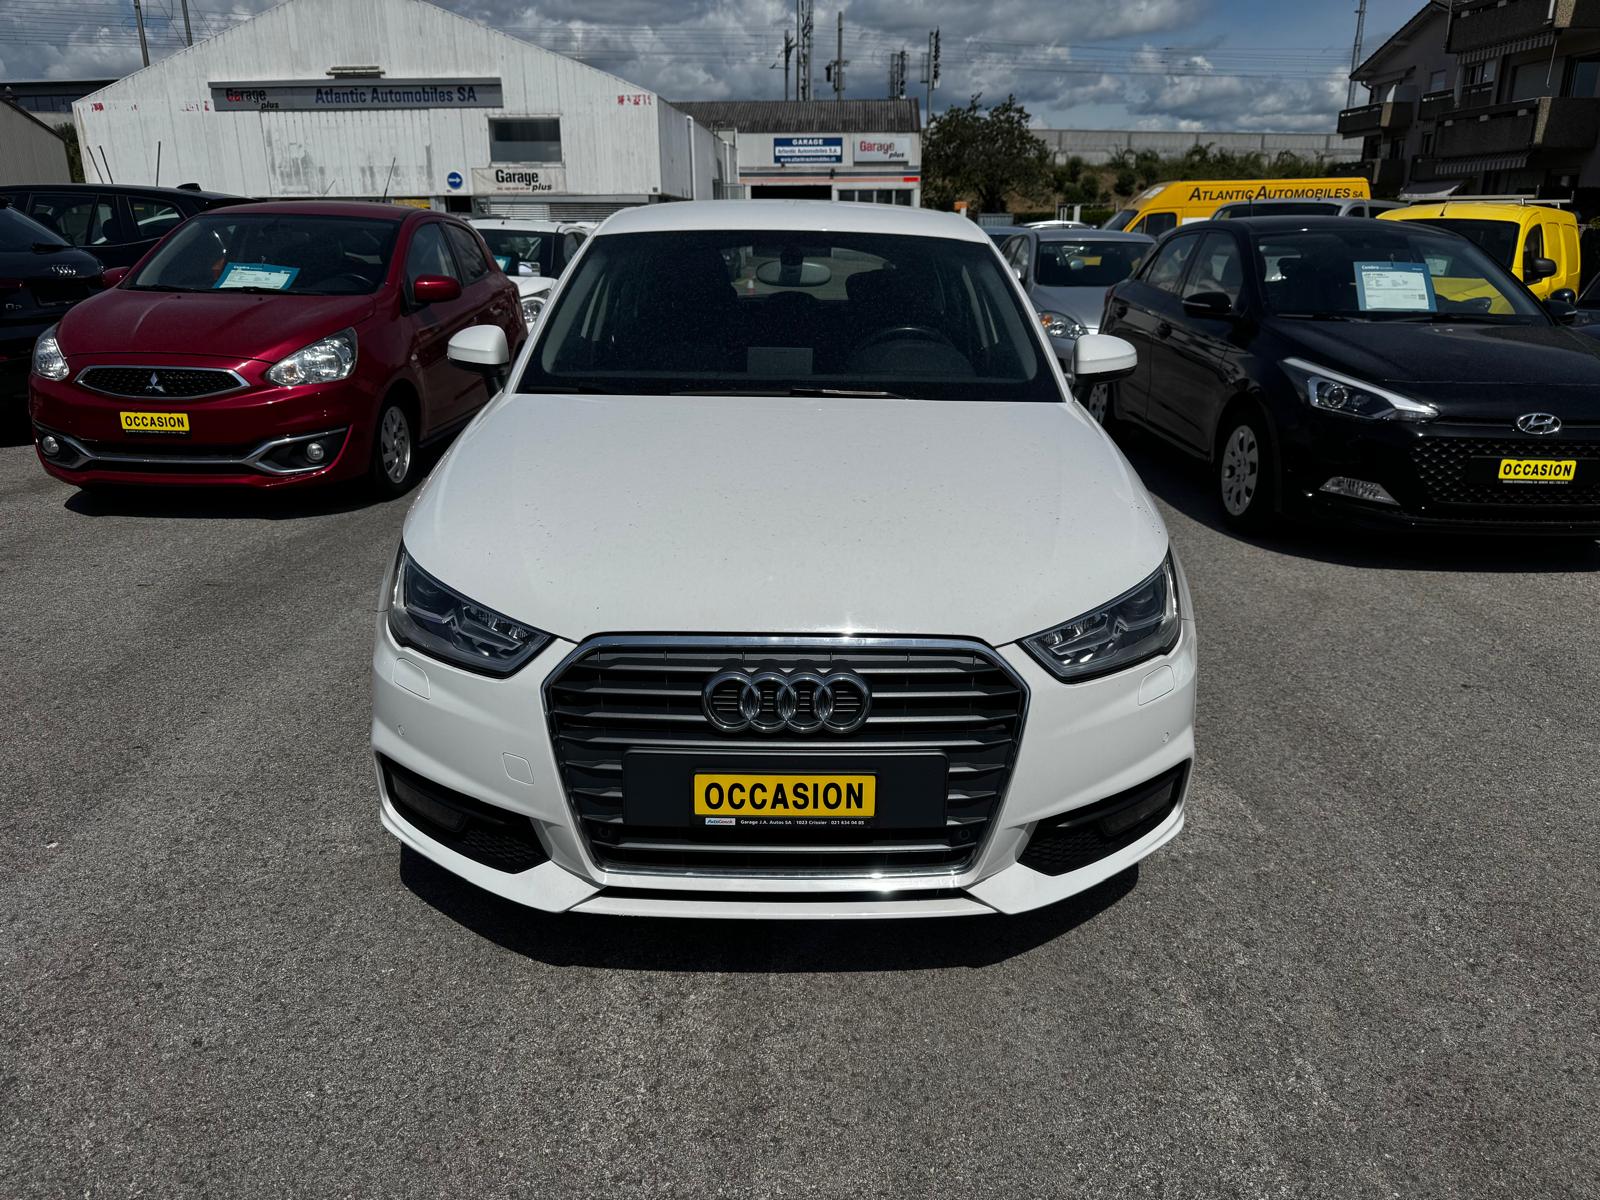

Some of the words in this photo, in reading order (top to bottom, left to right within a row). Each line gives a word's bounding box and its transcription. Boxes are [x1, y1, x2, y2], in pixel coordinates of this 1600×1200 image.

[225, 88, 267, 103] Garage
[315, 87, 366, 104] Atlantic
[370, 86, 453, 103] Automobiles
[457, 86, 477, 102] SA
[260, 100, 280, 110] plus
[792, 138, 824, 146] GARAGE
[859, 140, 895, 155] Garage
[888, 151, 905, 160] plus
[495, 168, 539, 186] Garage
[531, 183, 553, 193] plus
[1188, 186, 1254, 201] ATLANTIC
[1254, 185, 1351, 200] AUTOMOBILES
[1352, 190, 1364, 198] SA
[125, 416, 185, 427] OCCASION
[1503, 463, 1572, 476] OCCASION
[704, 782, 864, 810] OCCASION
